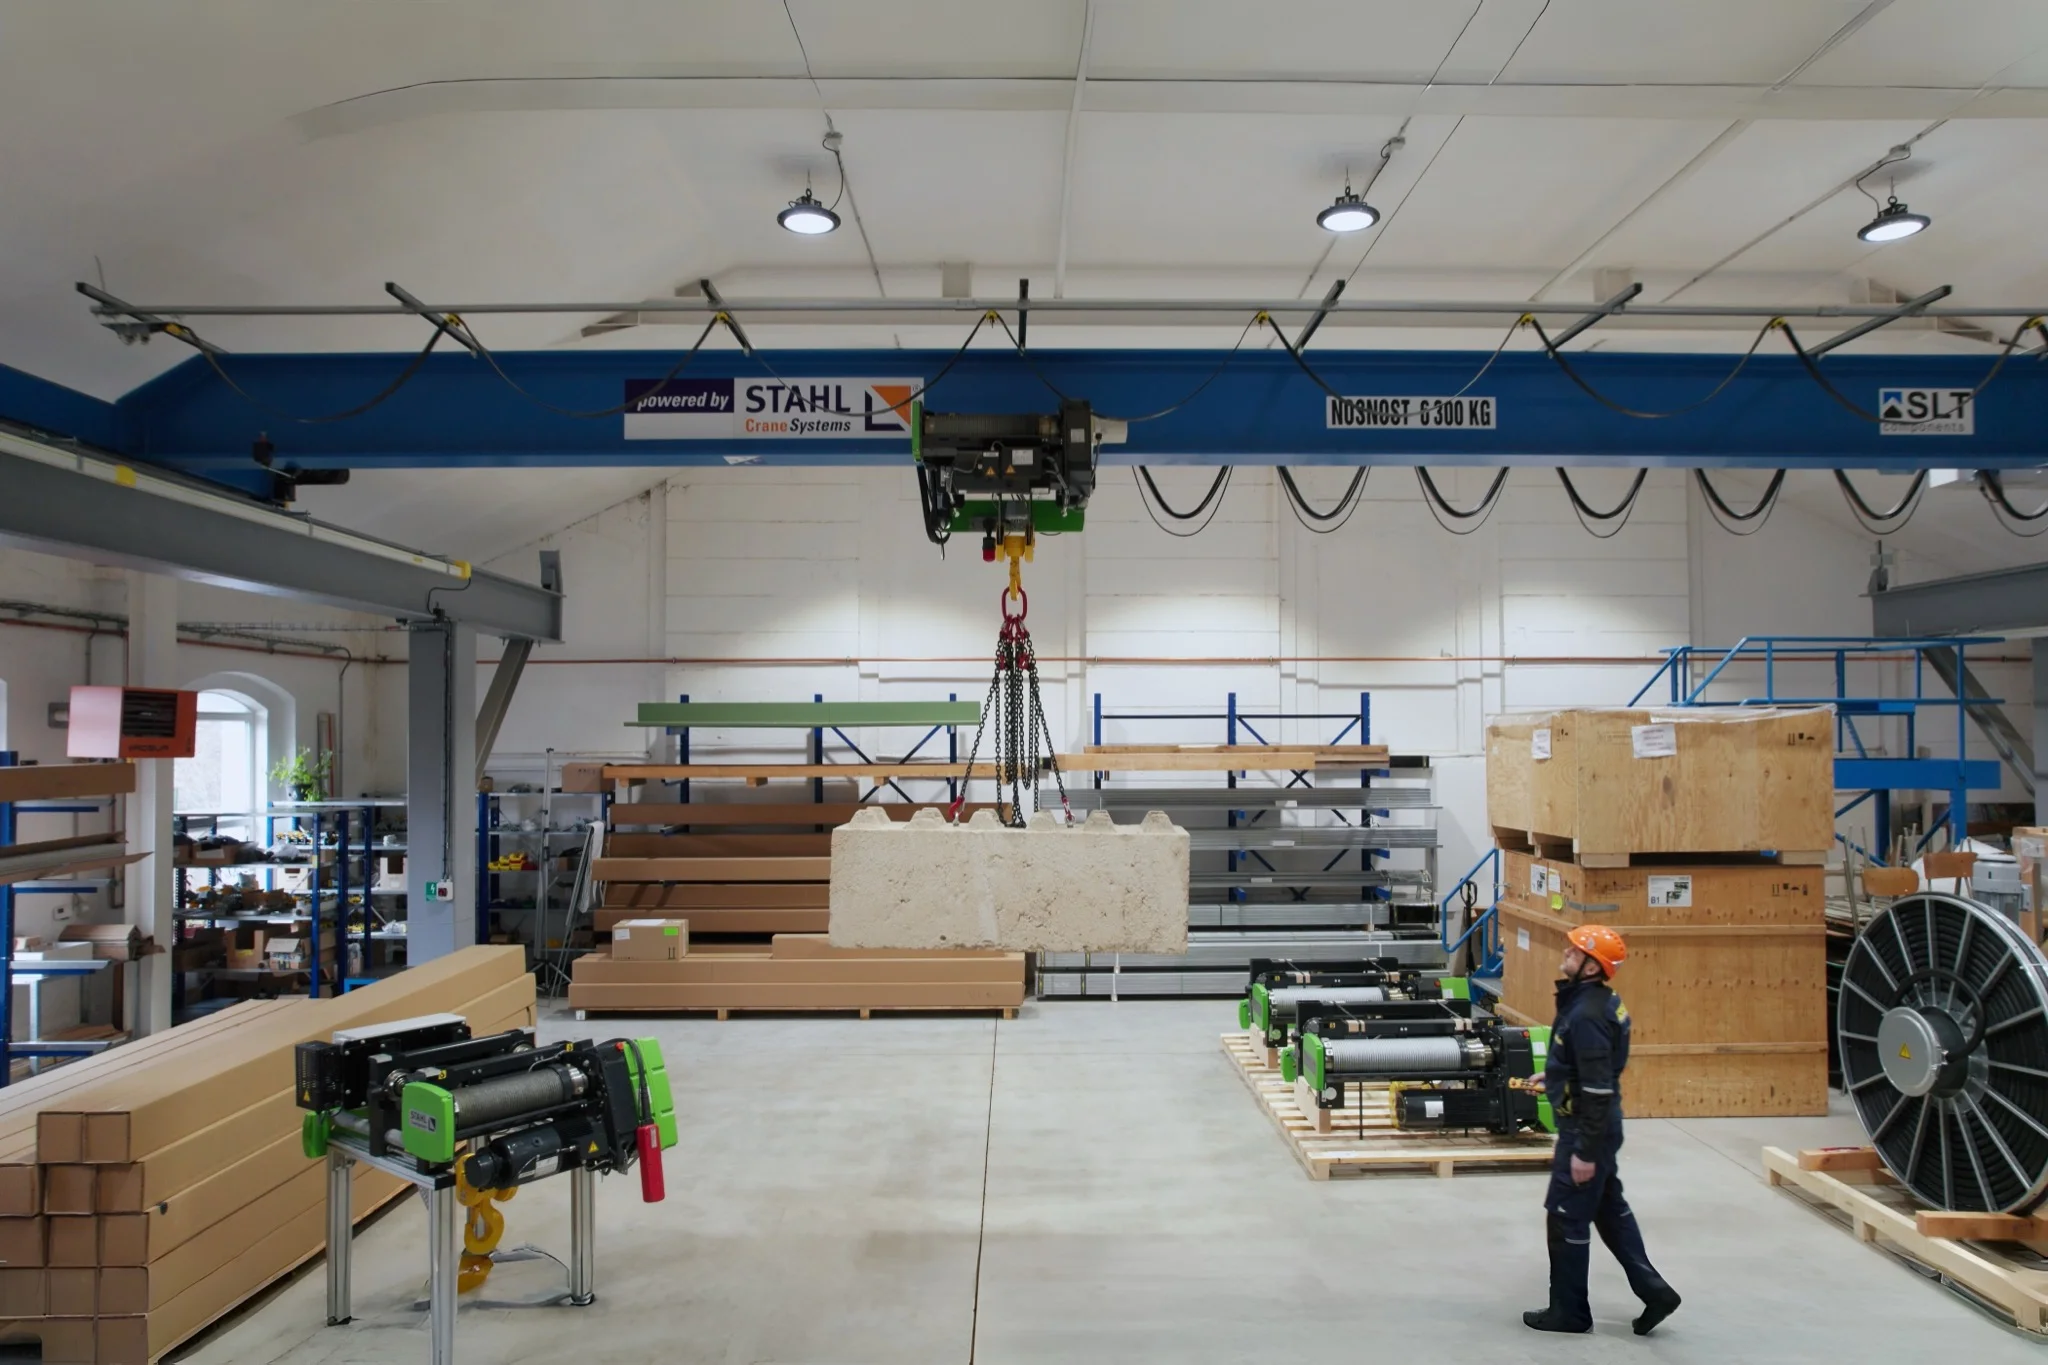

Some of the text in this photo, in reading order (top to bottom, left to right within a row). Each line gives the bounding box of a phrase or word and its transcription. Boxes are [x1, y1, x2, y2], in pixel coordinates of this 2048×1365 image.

[637, 391, 729, 412] powered by
[745, 384, 851, 413] STAHL
[1331, 398, 1410, 426] NOSNOST
[1469, 399, 1491, 426] KG
[1907, 391, 1971, 419] SLT
